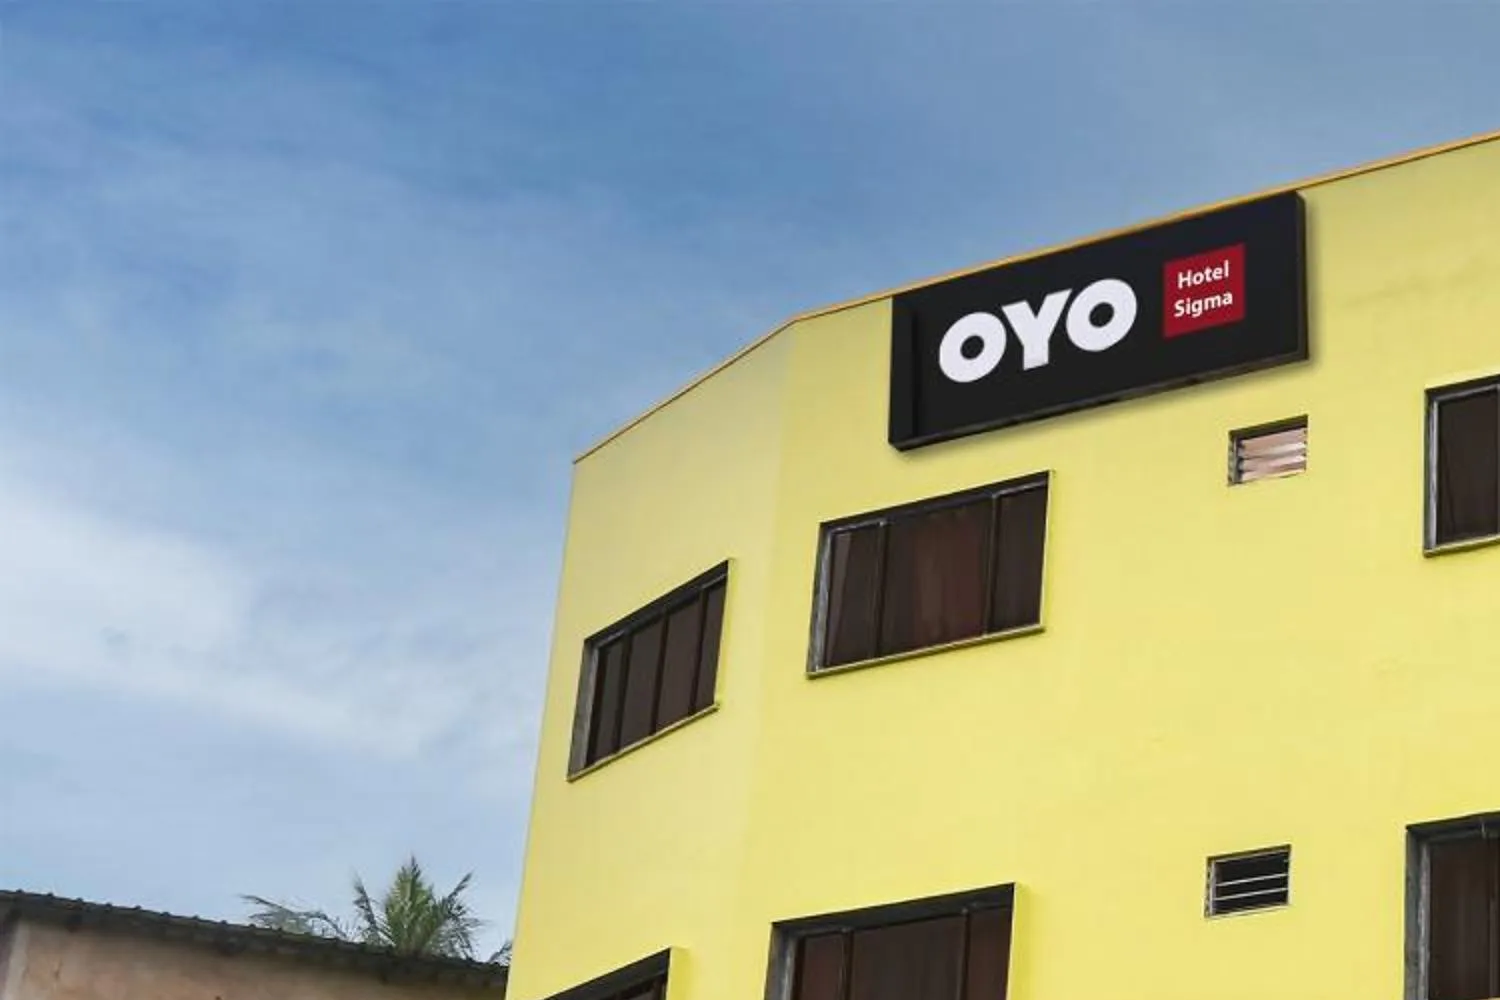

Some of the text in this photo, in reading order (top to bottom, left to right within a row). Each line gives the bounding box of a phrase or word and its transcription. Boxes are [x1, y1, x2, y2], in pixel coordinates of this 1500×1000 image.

[1177, 261, 1229, 290] Hotel
[1174, 291, 1233, 319] Sigma
[938, 278, 1137, 383] OYO
